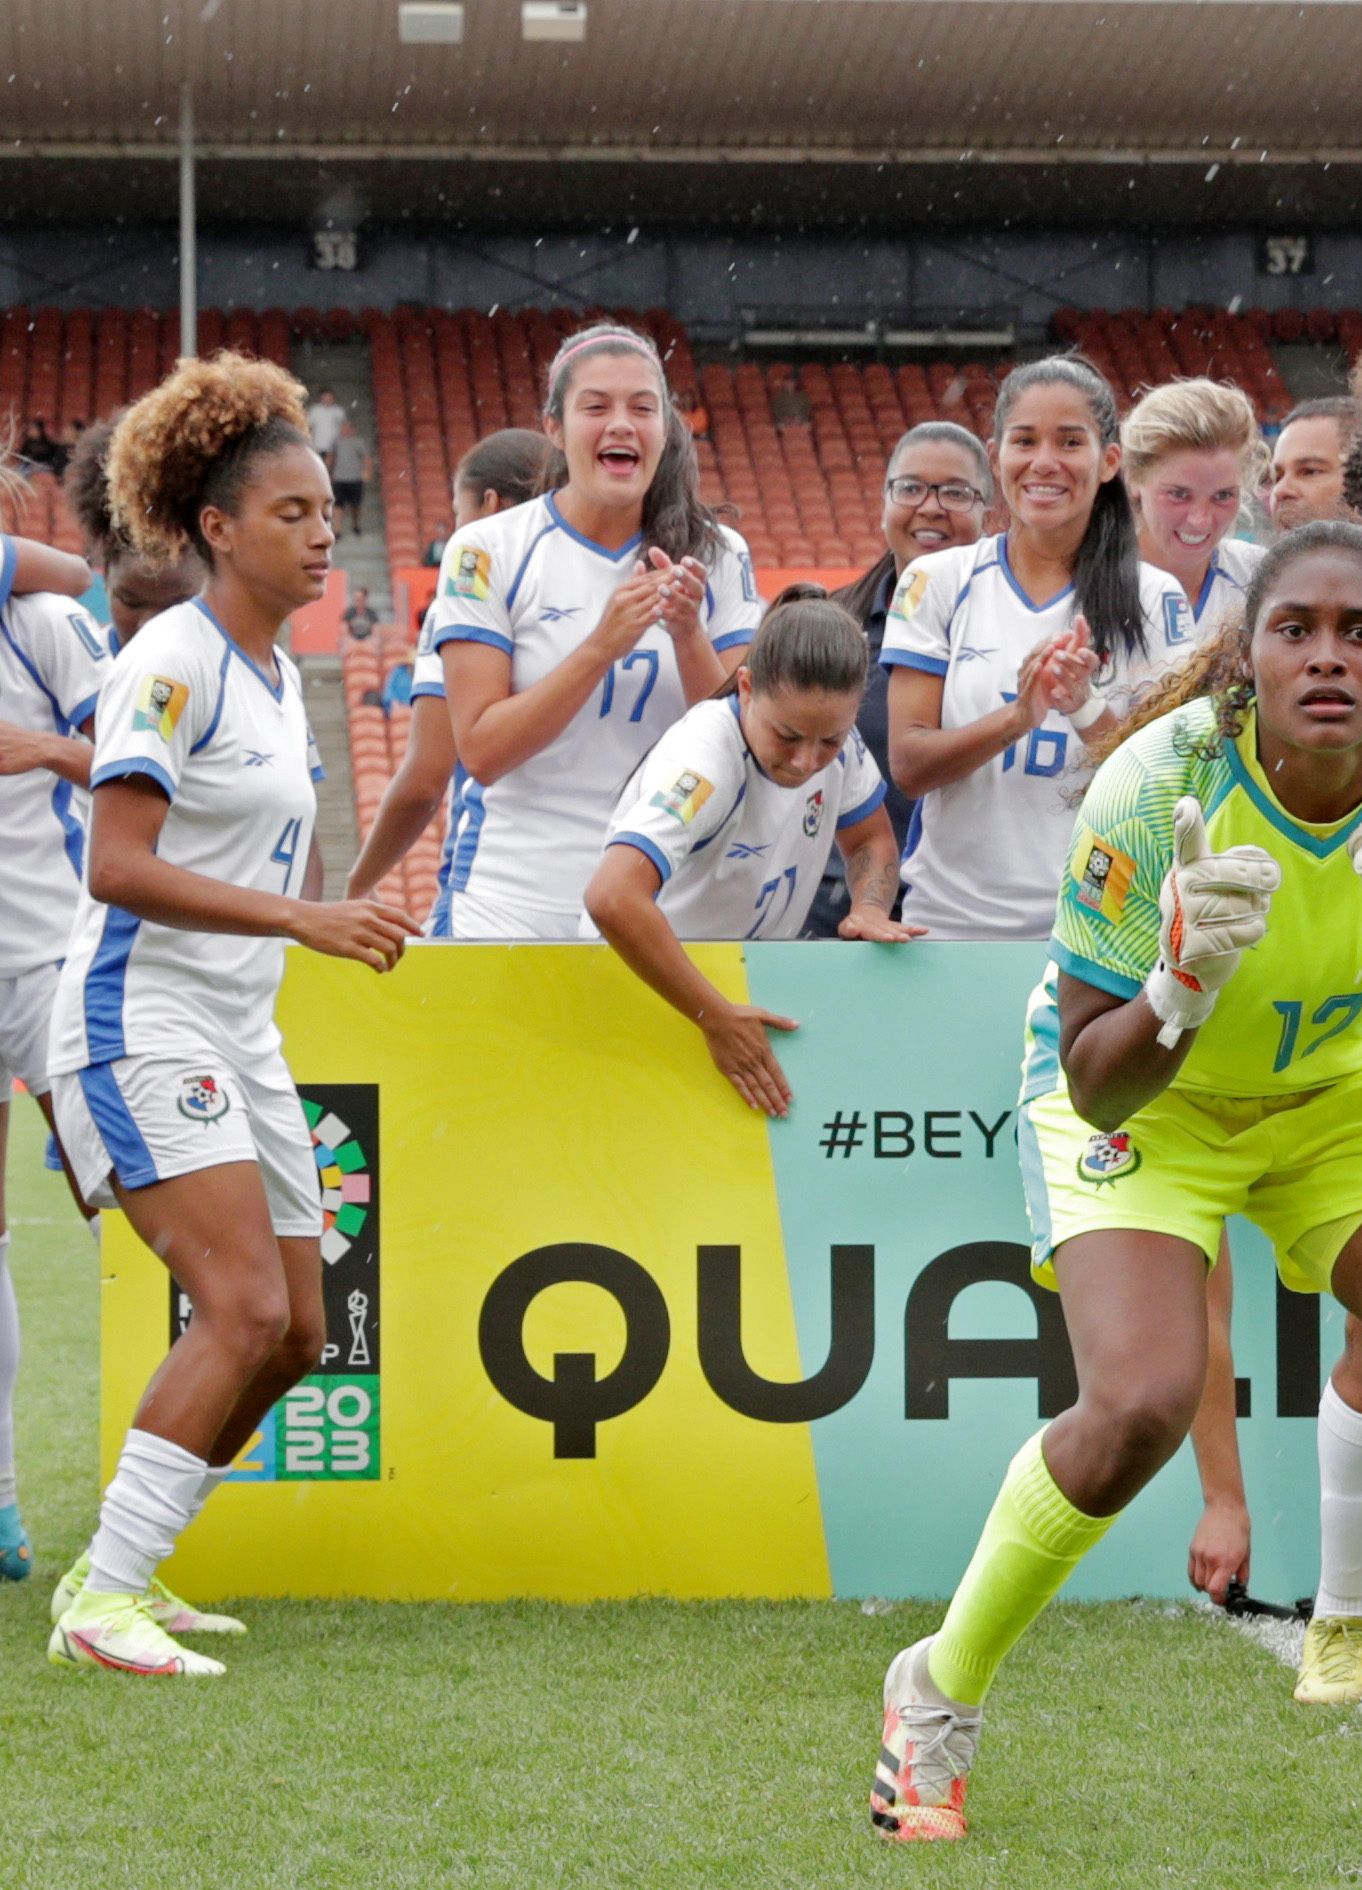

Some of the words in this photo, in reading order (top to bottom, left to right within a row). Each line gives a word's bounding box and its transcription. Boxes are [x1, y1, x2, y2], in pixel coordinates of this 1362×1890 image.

[270, 816, 303, 896] 4
[819, 1111, 1019, 1159] #BEY
[285, 1386, 372, 1427] 20
[285, 1430, 370, 1471] 23
